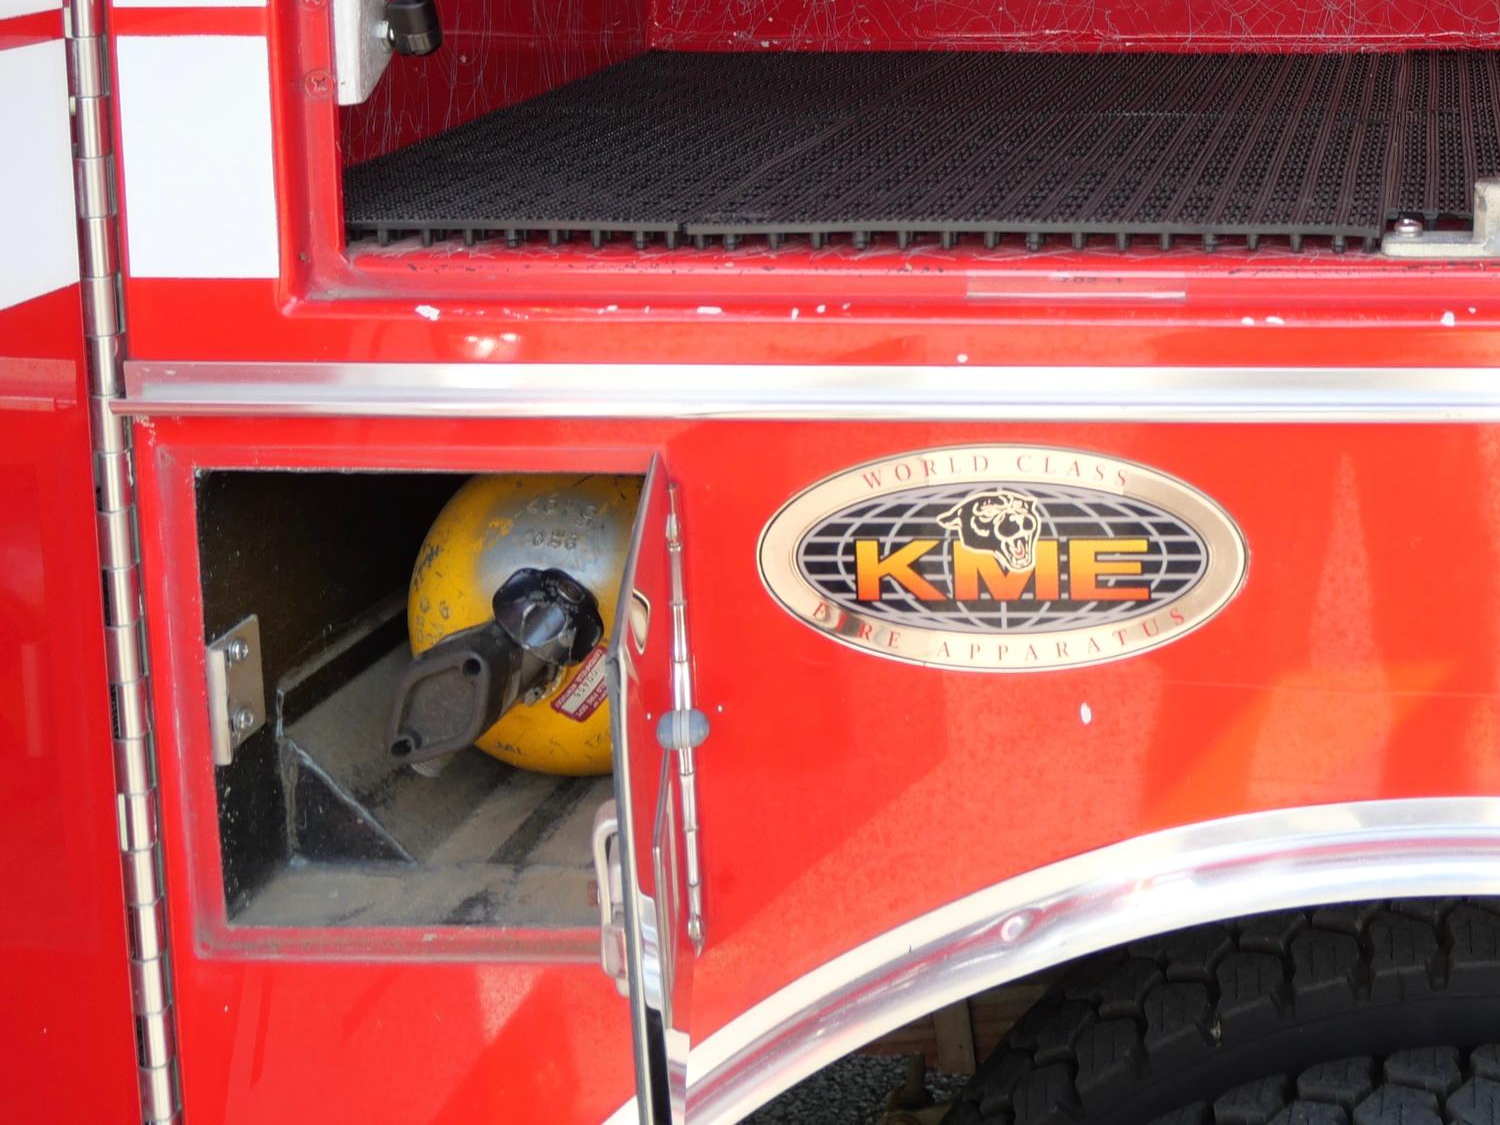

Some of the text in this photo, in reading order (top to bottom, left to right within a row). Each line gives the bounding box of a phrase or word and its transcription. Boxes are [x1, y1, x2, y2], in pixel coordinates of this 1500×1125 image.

[862, 454, 1127, 490] WORLD CLASS
[856, 539, 1150, 601] KME
[811, 601, 1186, 661] FIRE APPARATUS
